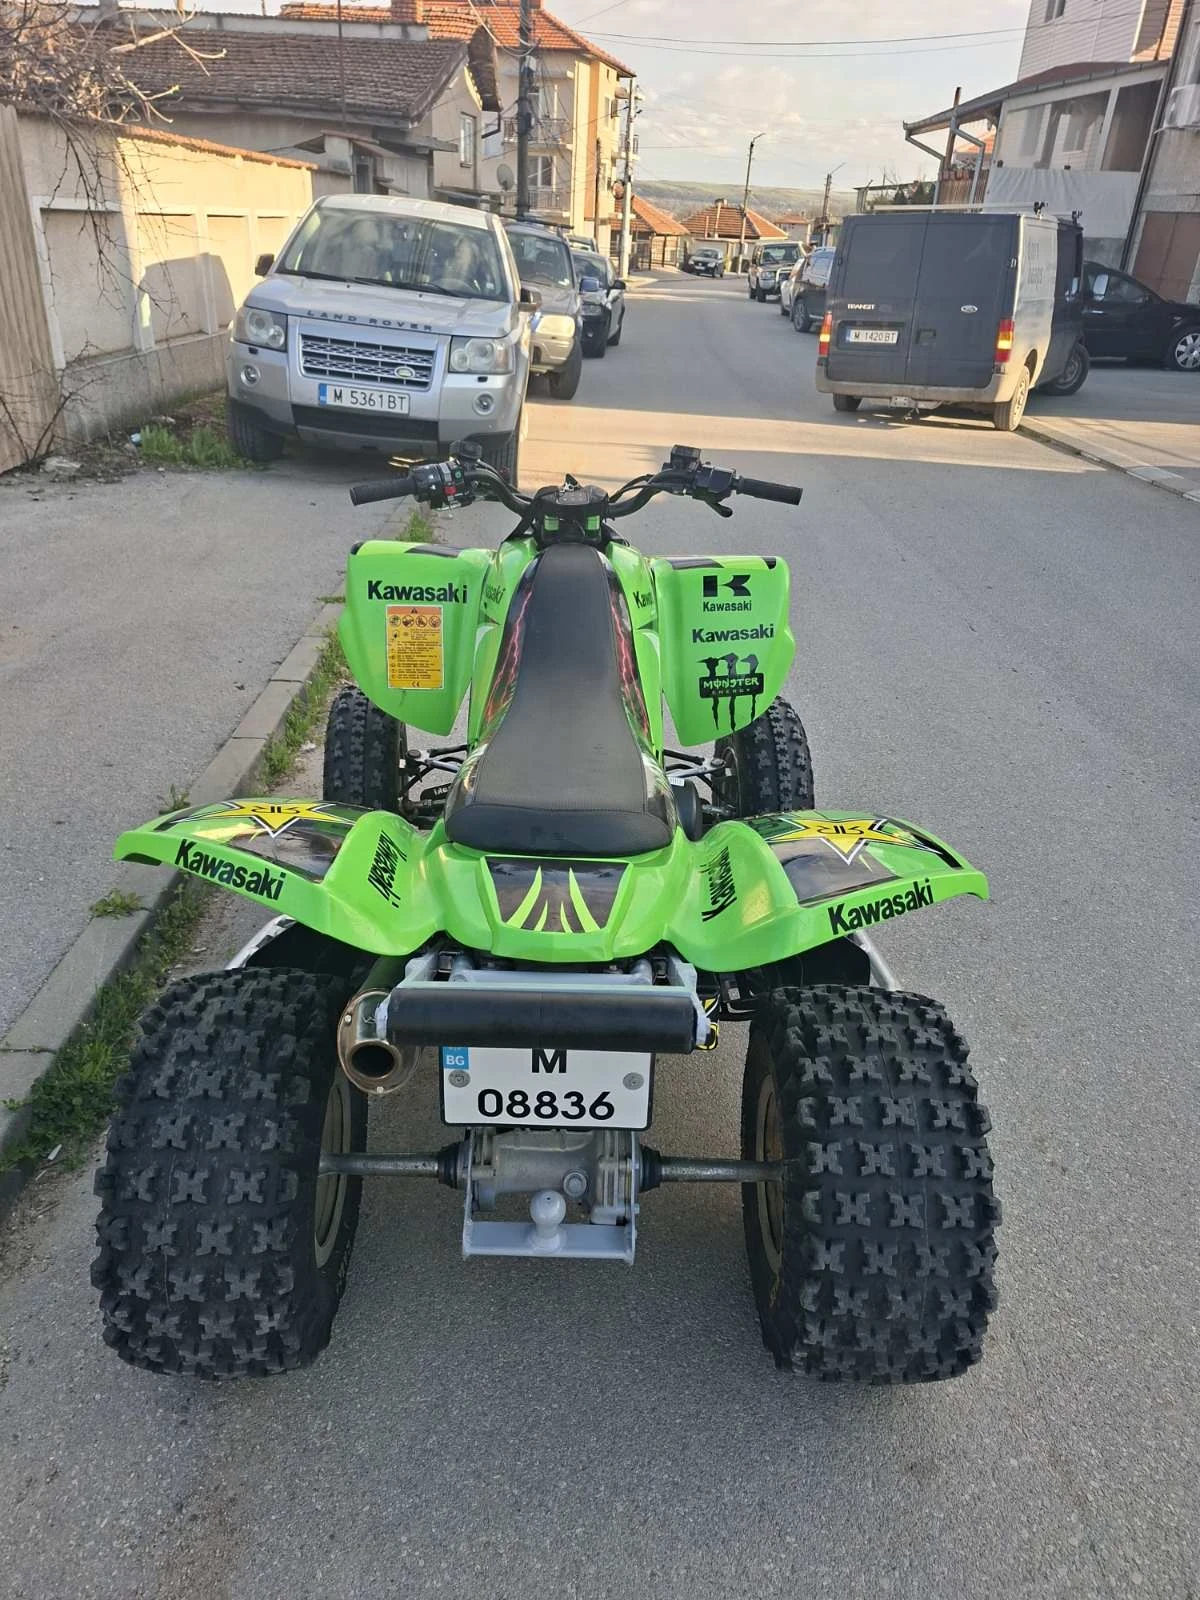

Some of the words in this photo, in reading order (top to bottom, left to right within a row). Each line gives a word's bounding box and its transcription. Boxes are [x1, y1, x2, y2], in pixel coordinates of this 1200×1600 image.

[307, 310, 357, 321] LAND
[369, 318, 432, 331] ROVER
[333, 388, 343, 404] M
[367, 580, 468, 604] Kawasaki
[703, 600, 752, 612] Kawasaki
[692, 624, 774, 643] Kawasaki
[703, 677, 760, 690] MONSTER
[174, 838, 287, 901] Kawasaki
[368, 830, 407, 909] Kawasaki
[827, 877, 934, 935] Kawasaki
[446, 1055, 465, 1066] BG
[531, 1049, 567, 1073] M
[477, 1088, 615, 1120] 08836
